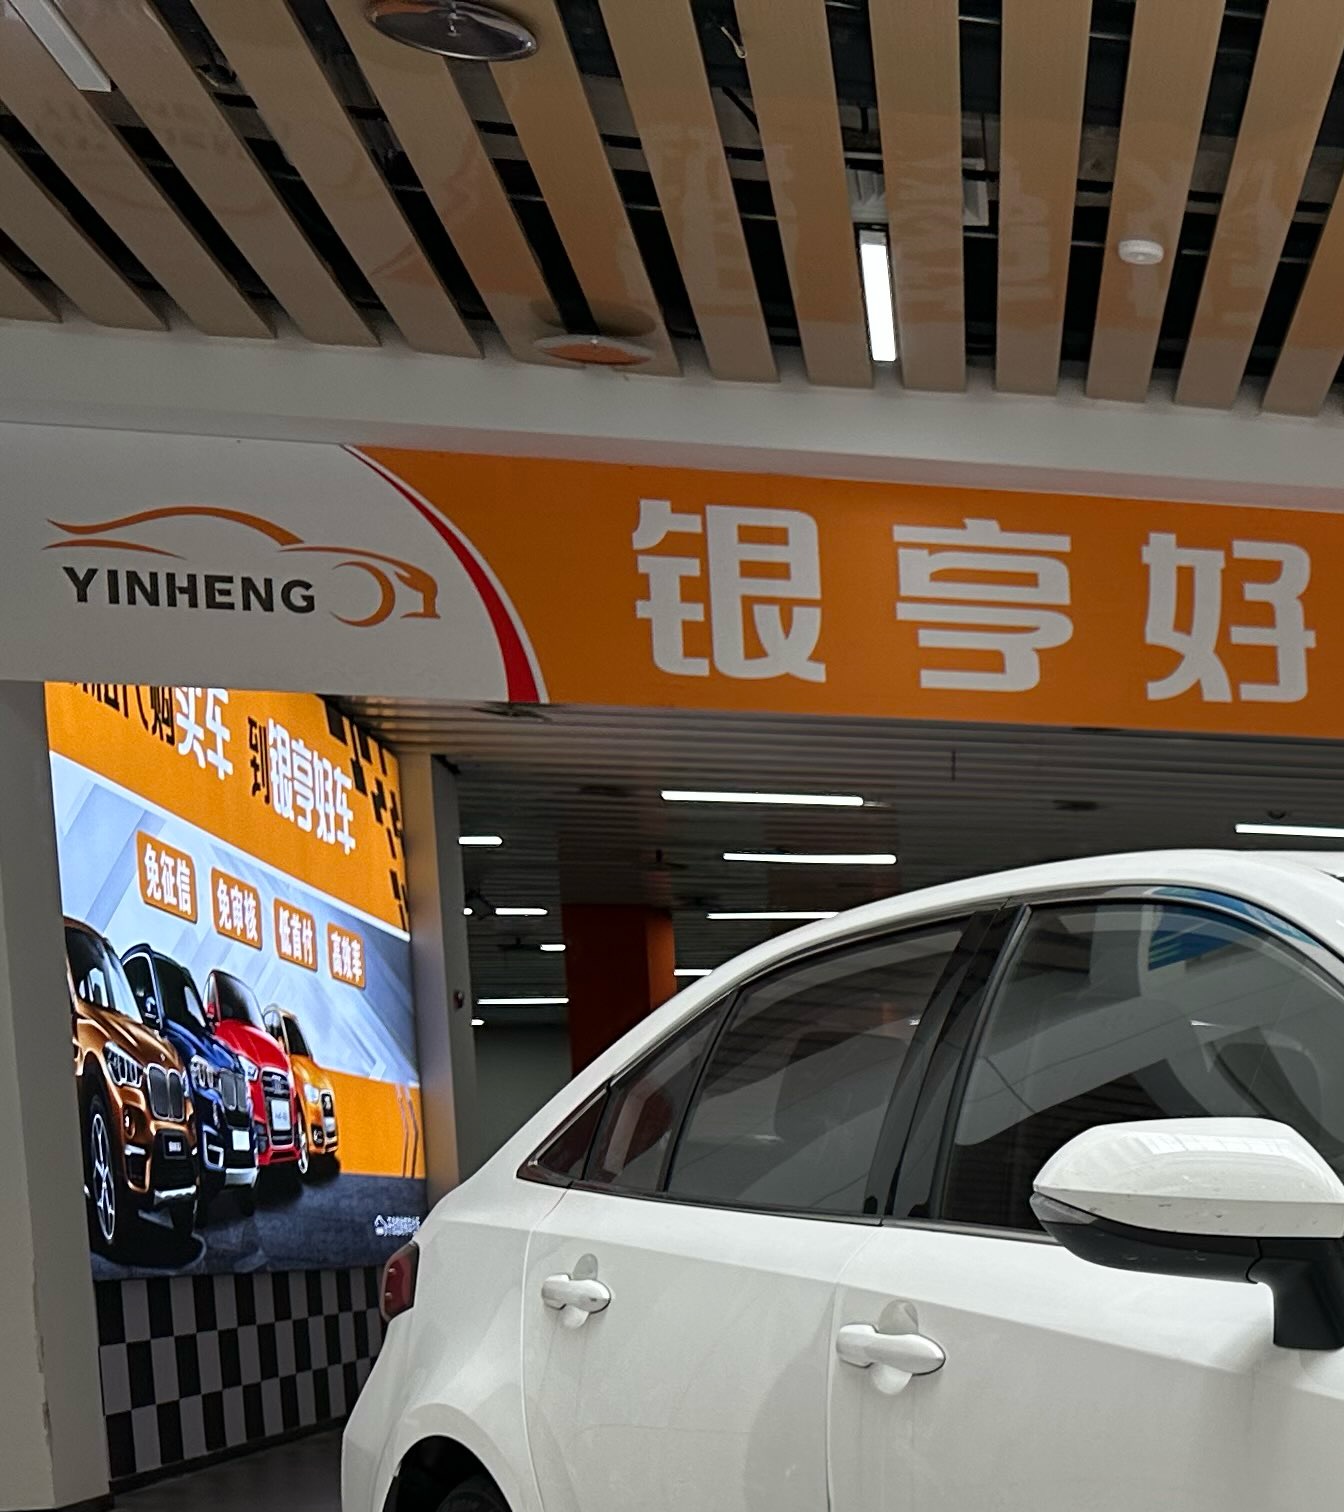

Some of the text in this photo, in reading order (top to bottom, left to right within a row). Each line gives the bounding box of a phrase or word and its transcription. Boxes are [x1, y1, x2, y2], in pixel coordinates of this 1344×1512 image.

[62, 565, 316, 614] YINHENG
[248, 716, 356, 855] 到银亨好车
[143, 842, 193, 916] 免征信
[216, 878, 259, 942] 免审核
[278, 906, 314, 965] 低首付
